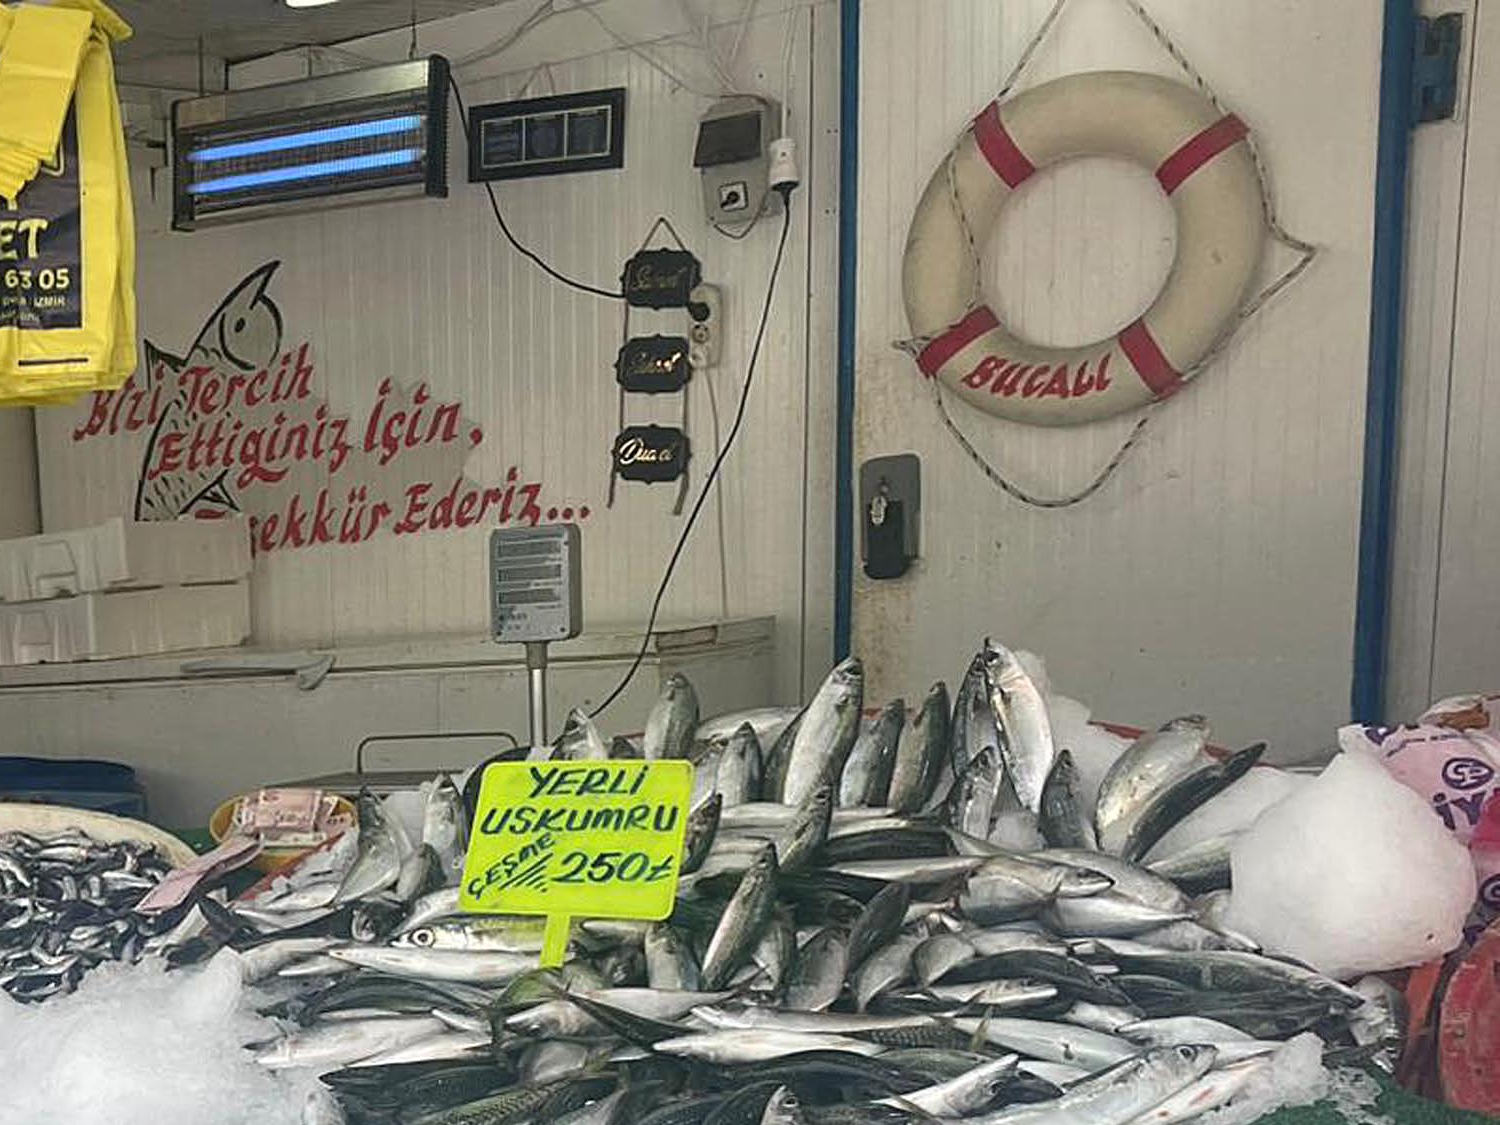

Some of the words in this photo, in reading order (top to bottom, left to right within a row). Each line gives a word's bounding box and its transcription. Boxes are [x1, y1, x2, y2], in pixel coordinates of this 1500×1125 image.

[39, 268, 69, 289] 05
[178, 343, 313, 414] Tercih
[528, 765, 649, 798] YERLİ
[480, 804, 679, 835] USKUMRU
